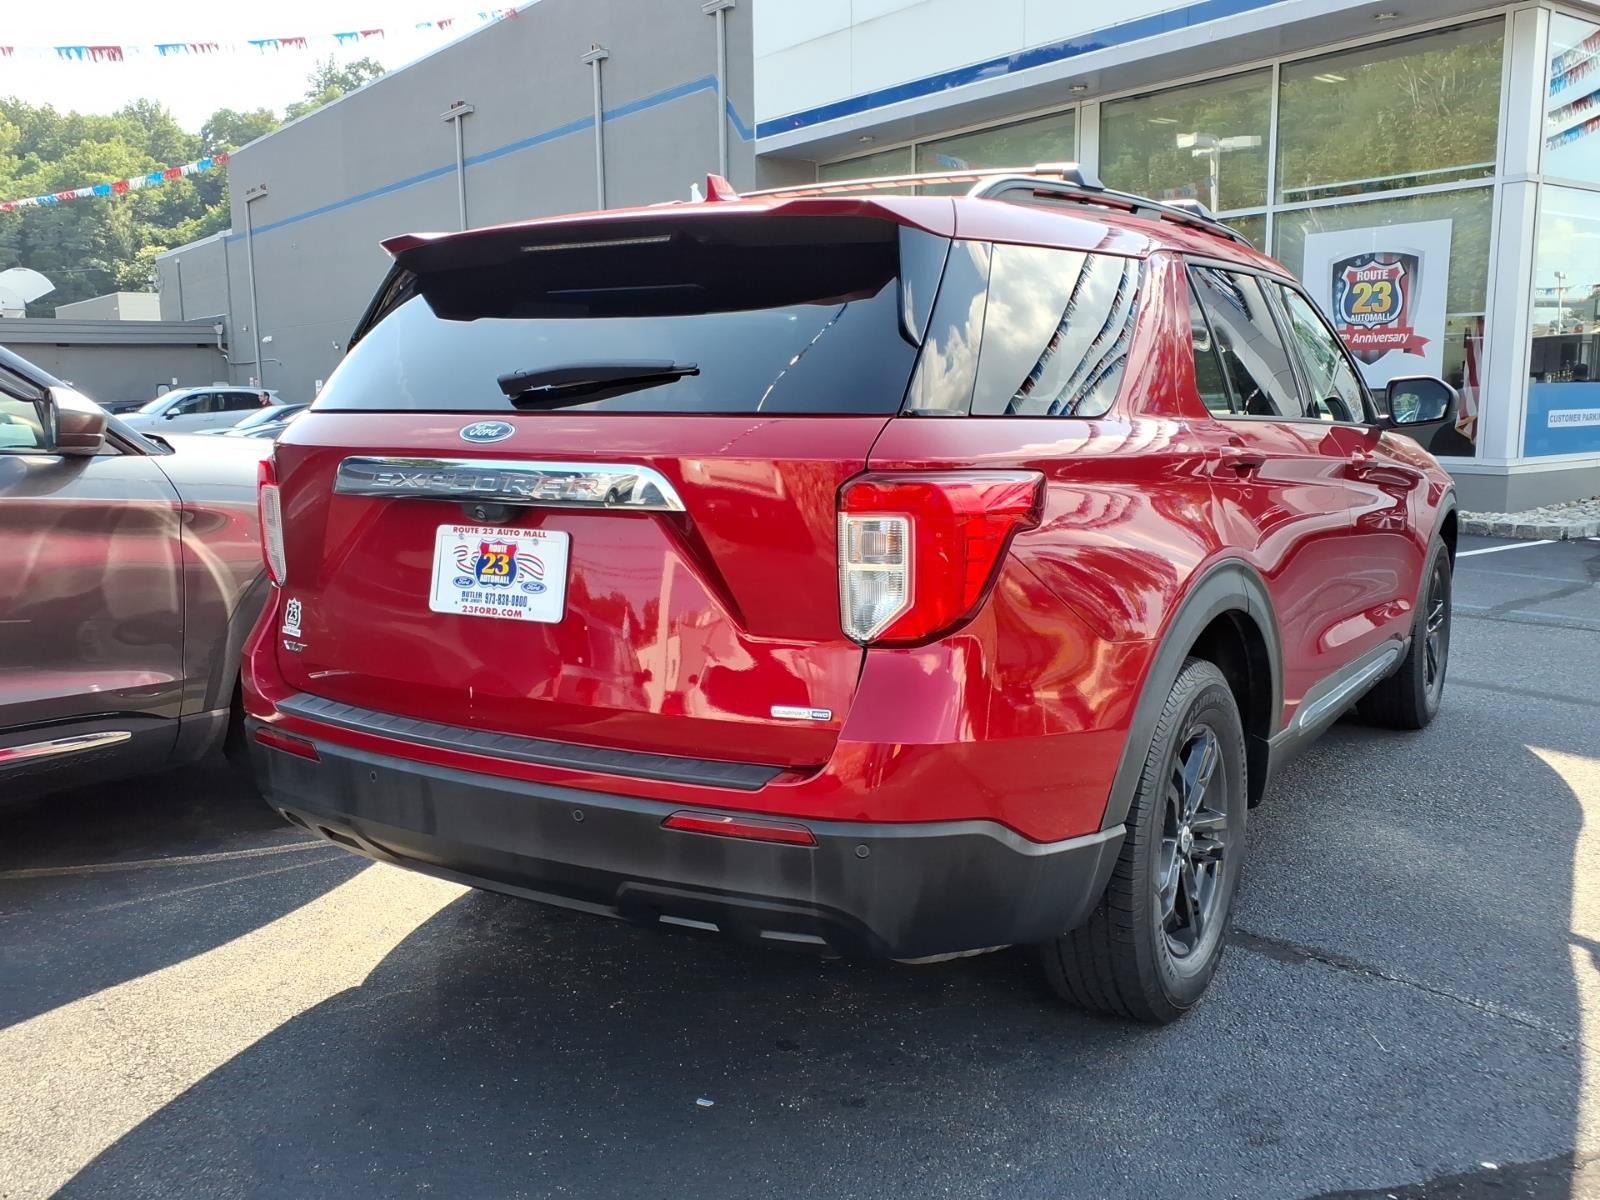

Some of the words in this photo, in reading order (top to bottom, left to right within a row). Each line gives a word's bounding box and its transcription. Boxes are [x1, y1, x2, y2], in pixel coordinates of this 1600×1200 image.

[1357, 269, 1389, 281] ROUTE
[1352, 281, 1392, 314] 23
[1350, 313, 1392, 323] AUTOMALL
[1351, 332, 1410, 344] Anniversary
[1550, 413, 1582, 423] CUSTOMER
[1582, 412, 1600, 422] PARKI
[469, 422, 502, 437] Ford
[372, 472, 599, 499] EXPLORER
[452, 526, 479, 534] ROUTE
[482, 527, 494, 535] 23
[497, 529, 520, 537] AUTO
[523, 530, 547, 538] MALL
[482, 553, 509, 575] 23
[462, 605, 522, 617] 23FORD.COM
